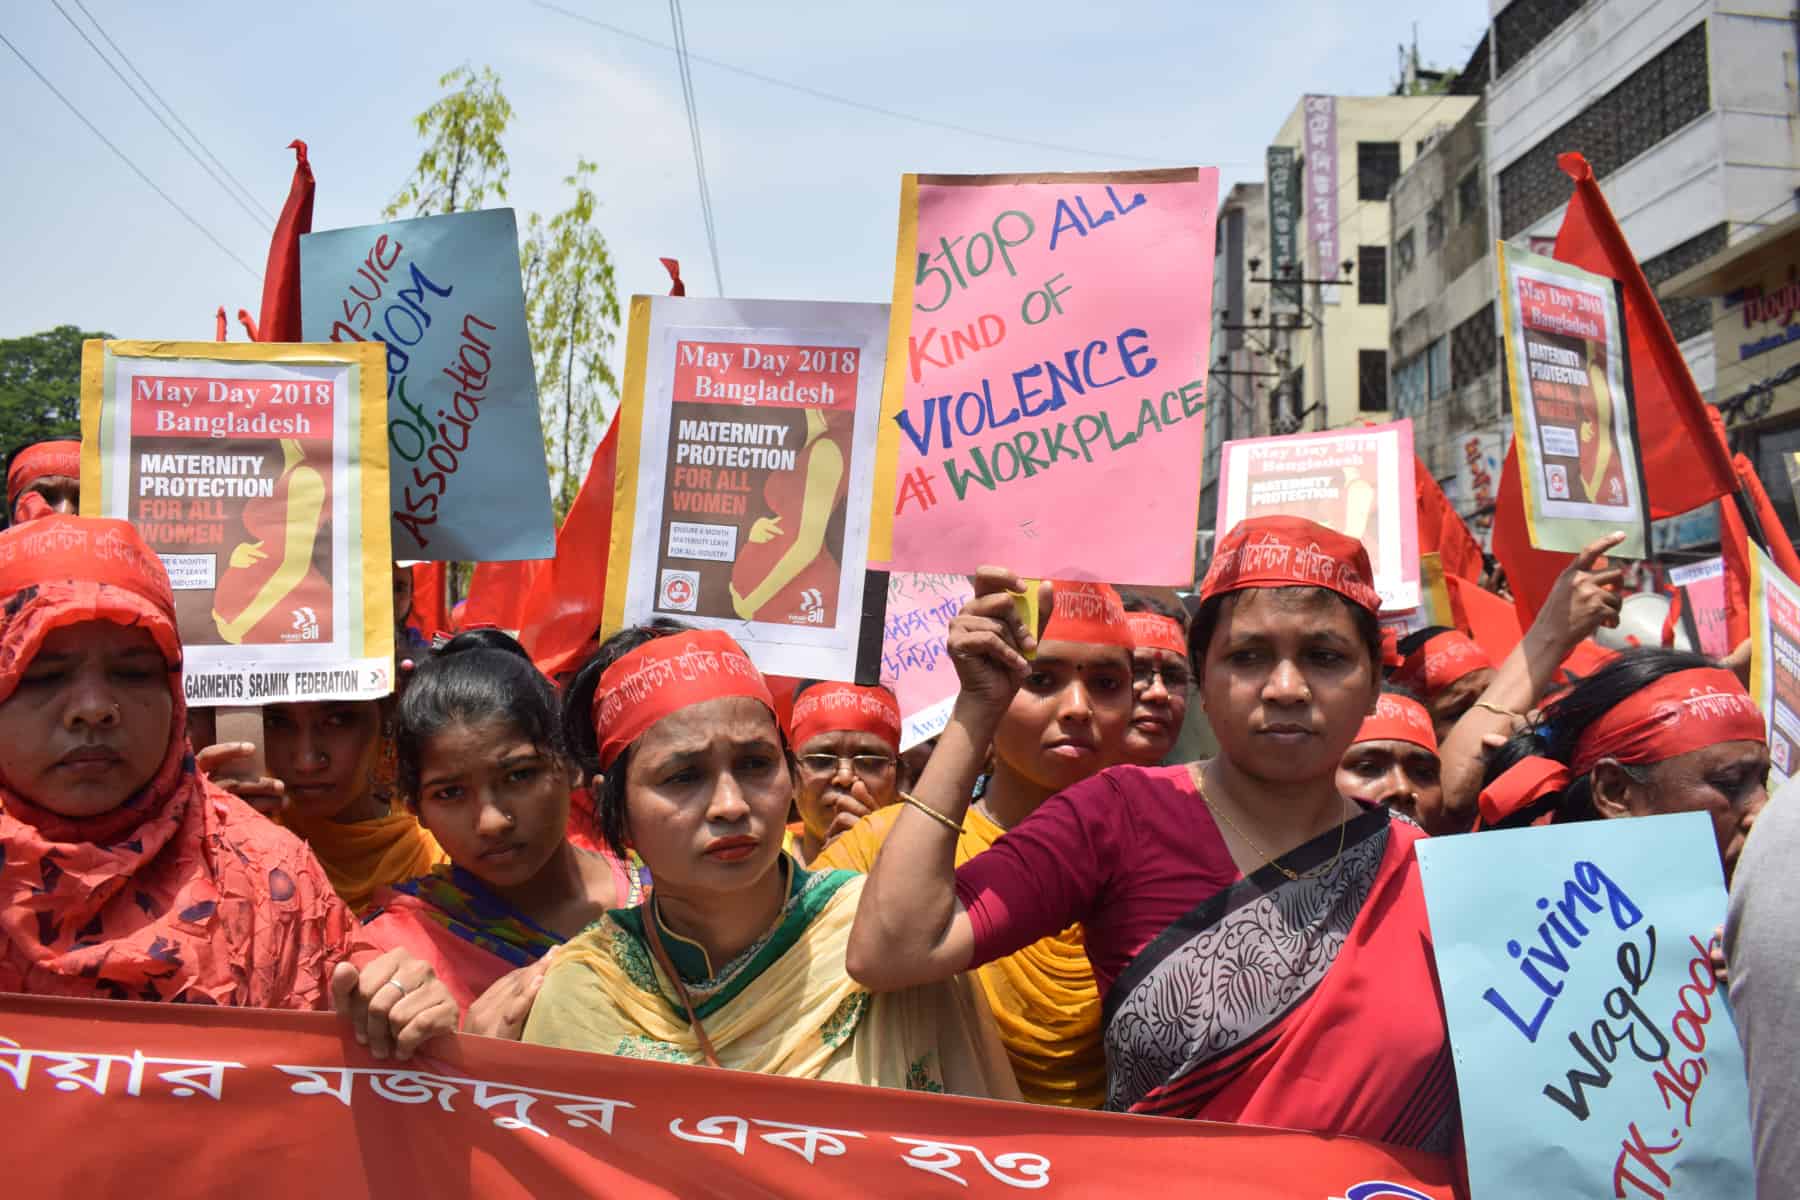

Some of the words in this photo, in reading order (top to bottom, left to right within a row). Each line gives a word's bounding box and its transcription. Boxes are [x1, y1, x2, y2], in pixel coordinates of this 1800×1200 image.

[1050, 185, 1147, 250] ALL
[907, 313, 1007, 383] KIND
[1020, 273, 1072, 325] OF
[677, 344, 734, 372] May
[741, 350, 792, 377] Day
[798, 350, 857, 374] 2018
[135, 379, 199, 407] May
[207, 380, 262, 409] Day
[269, 382, 331, 405] 2018
[694, 375, 836, 406] Bangladesh
[893, 328, 1158, 456] VIOLENCE
[155, 409, 312, 438] Bangladesh
[679, 419, 789, 447] MATERNITY
[942, 379, 1205, 502] WORKPLACE
[140, 454, 264, 476] MATERNITY
[675, 443, 796, 472] PROTECTION
[139, 477, 273, 498] PROTECTION
[674, 467, 712, 490] FOR
[716, 470, 752, 493] ALL
[139, 500, 181, 521] FOR
[188, 500, 225, 521] ALL
[671, 490, 747, 515] WOMEN
[137, 523, 224, 544] WOMEN
[185, 672, 243, 699] GARMENTS
[249, 671, 289, 697] SRAMIK
[294, 670, 358, 695] FEDERATION
[1482, 860, 1644, 1043] Living
[1542, 925, 1670, 1121] Wage
[272, 1064, 636, 1137] মজদুর
[668, 1115, 868, 1166] এক
[890, 1135, 1052, 1190] হও
